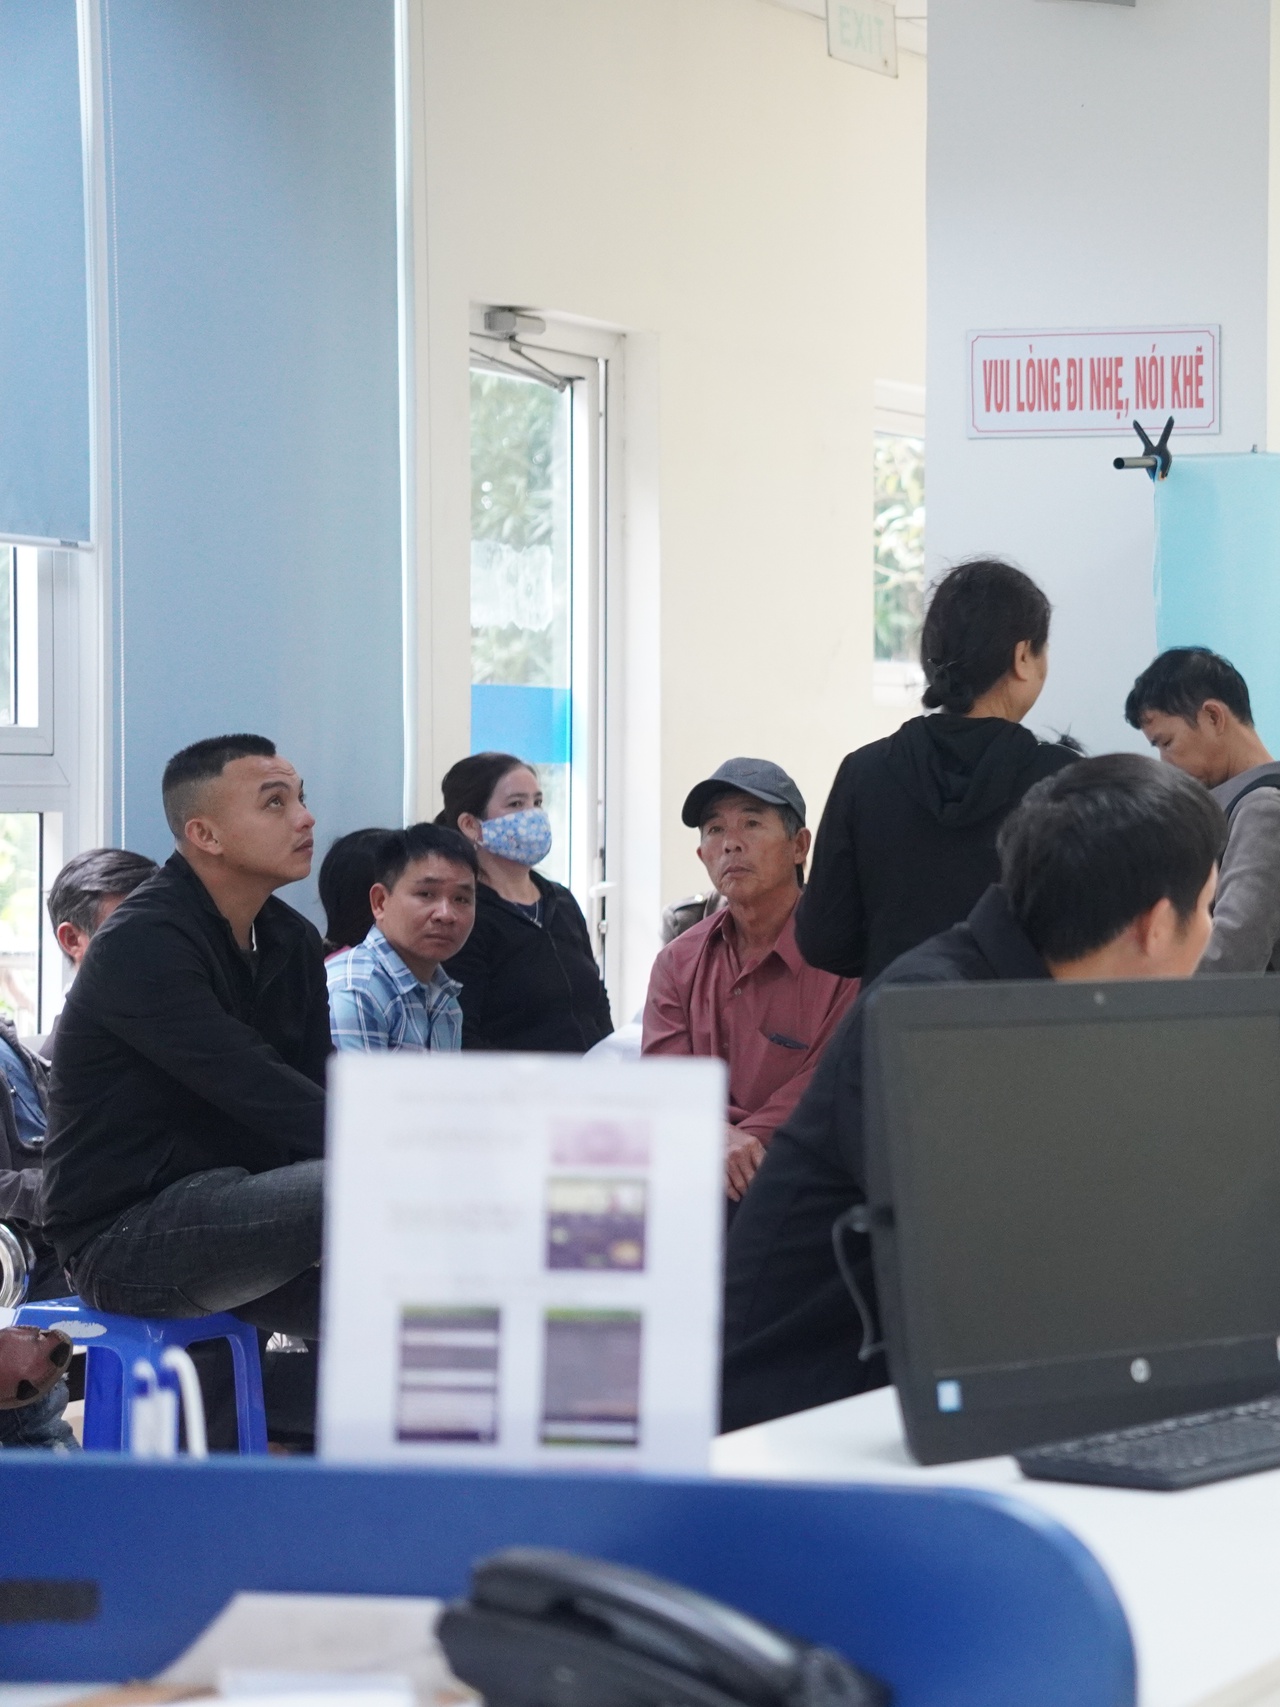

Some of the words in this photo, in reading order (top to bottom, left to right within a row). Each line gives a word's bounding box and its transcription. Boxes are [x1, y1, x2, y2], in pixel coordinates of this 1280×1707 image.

[838, 5, 884, 55] EXIT
[982, 359, 1011, 413] VUI
[1016, 344, 1061, 412] LÒNG
[1066, 357, 1084, 411] ĐI
[1089, 356, 1130, 419] NHẸ,
[1135, 343, 1165, 410] NÓI
[1171, 345, 1205, 409] KHẼ
